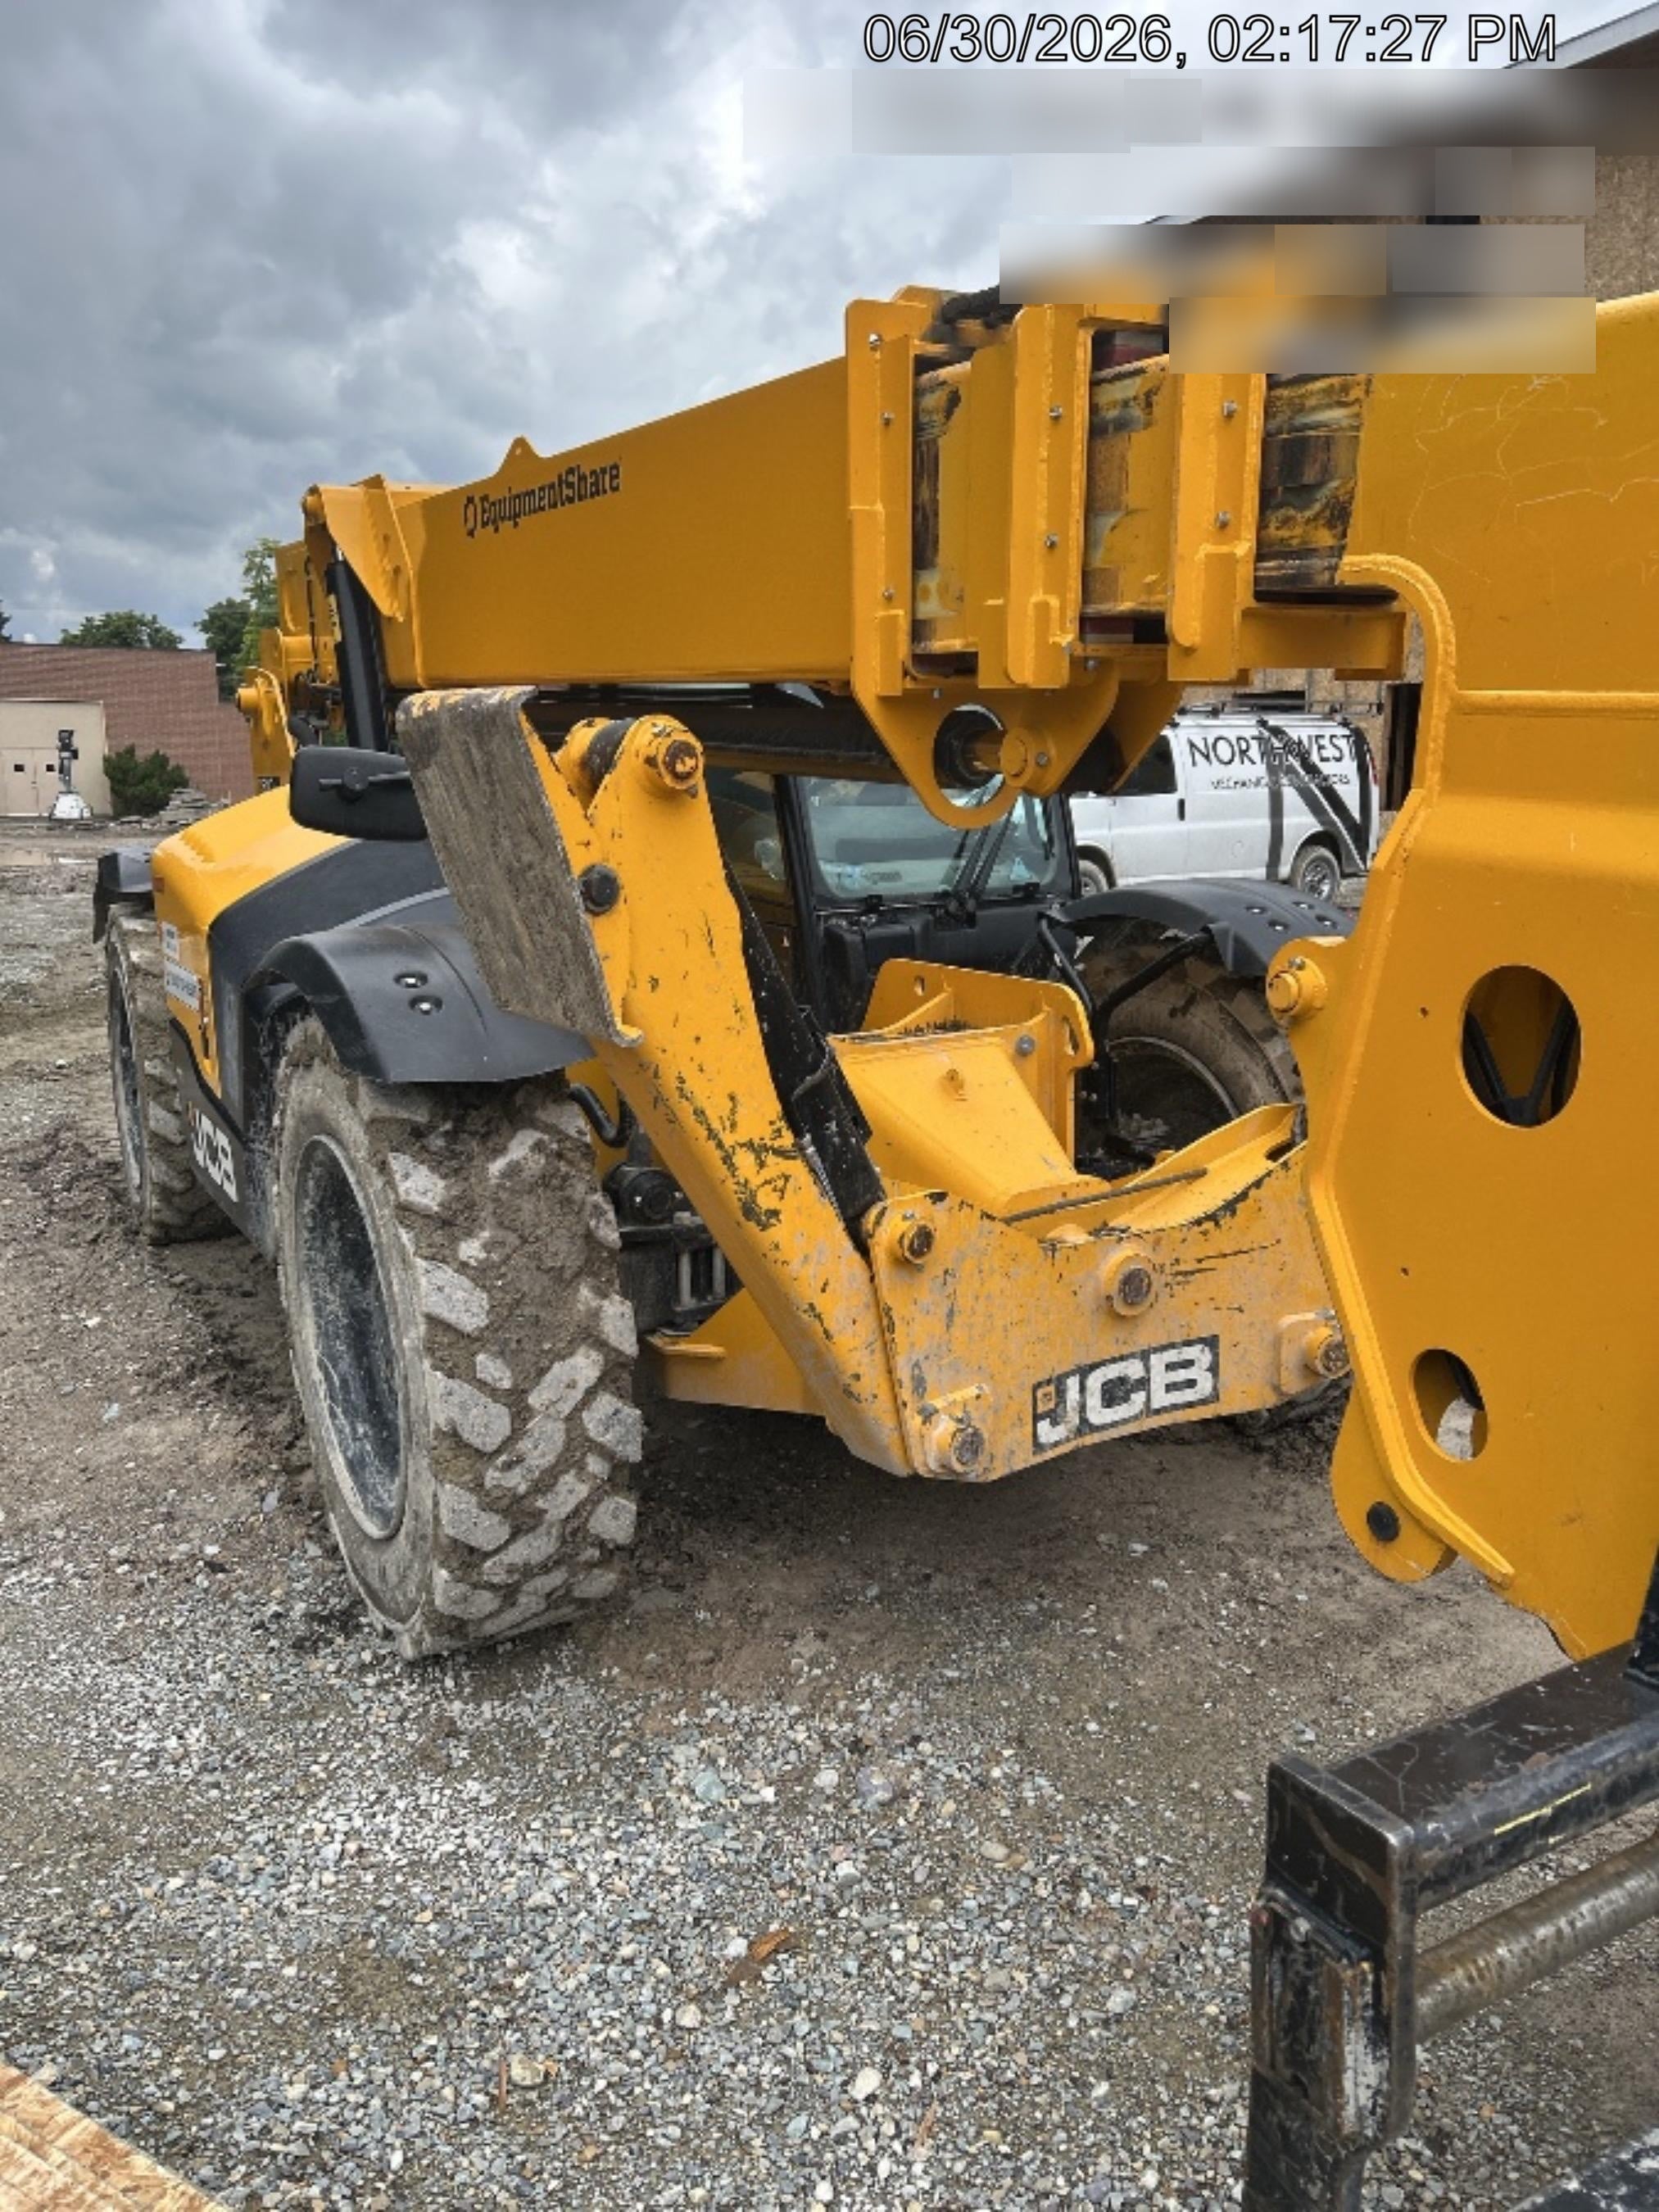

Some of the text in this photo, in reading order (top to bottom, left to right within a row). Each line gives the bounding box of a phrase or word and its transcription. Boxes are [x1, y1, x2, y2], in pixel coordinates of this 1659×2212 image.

[479, 462, 621, 533] EquipmentShare
[192, 1108, 238, 1203] JCB
[1036, 1343, 1213, 1444] JCB
